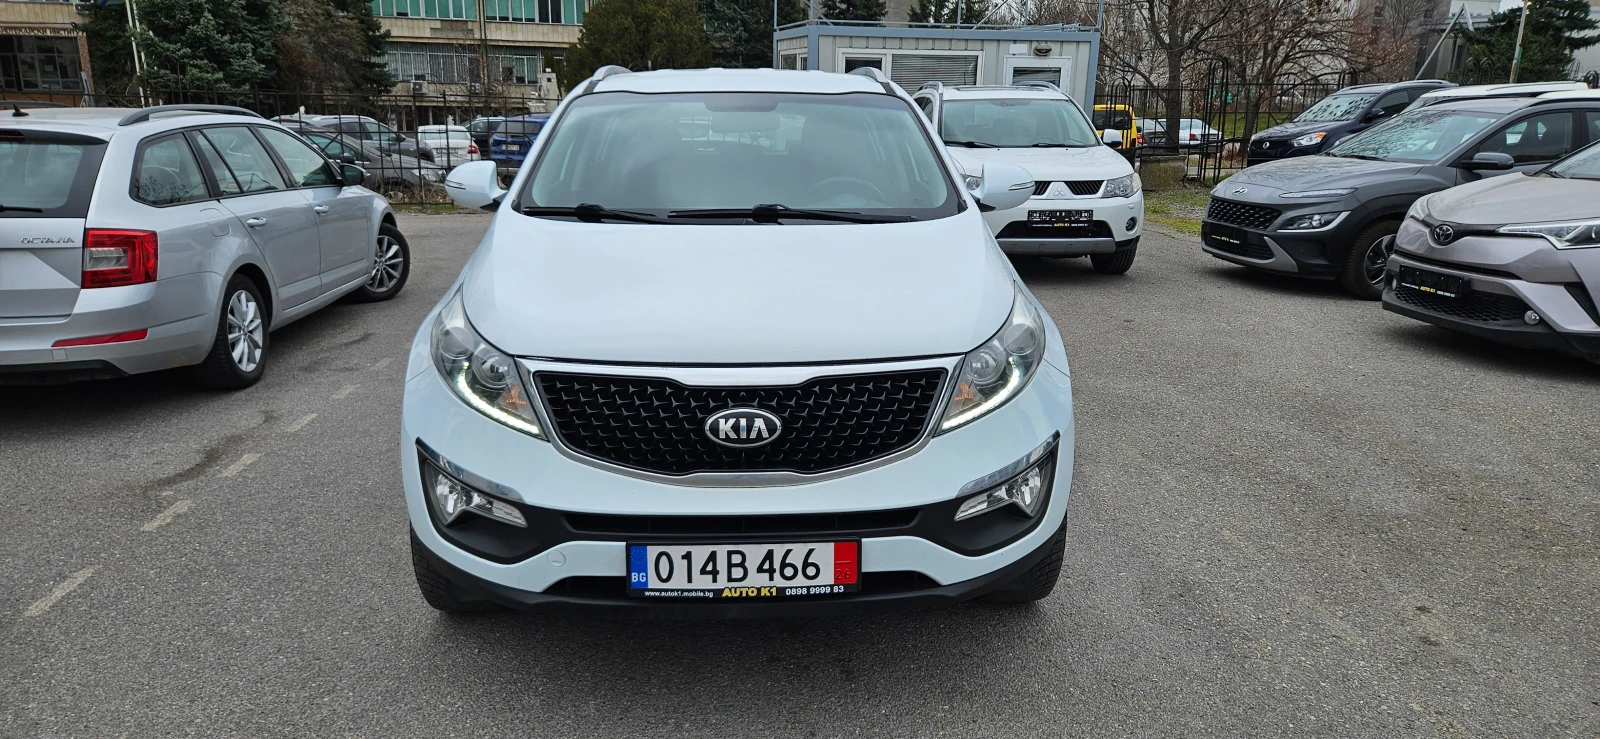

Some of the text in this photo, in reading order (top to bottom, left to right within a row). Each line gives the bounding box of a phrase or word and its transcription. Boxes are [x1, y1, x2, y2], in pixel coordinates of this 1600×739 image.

[20, 237, 75, 245] OCTAVIA
[718, 418, 769, 439] KIA
[631, 572, 647, 582] BG
[835, 568, 851, 580] 26
[722, 587, 758, 597] AUTO
[761, 587, 777, 596] K1
[786, 588, 807, 596] 0898
[810, 586, 831, 595] 9999
[833, 585, 845, 593] 83
